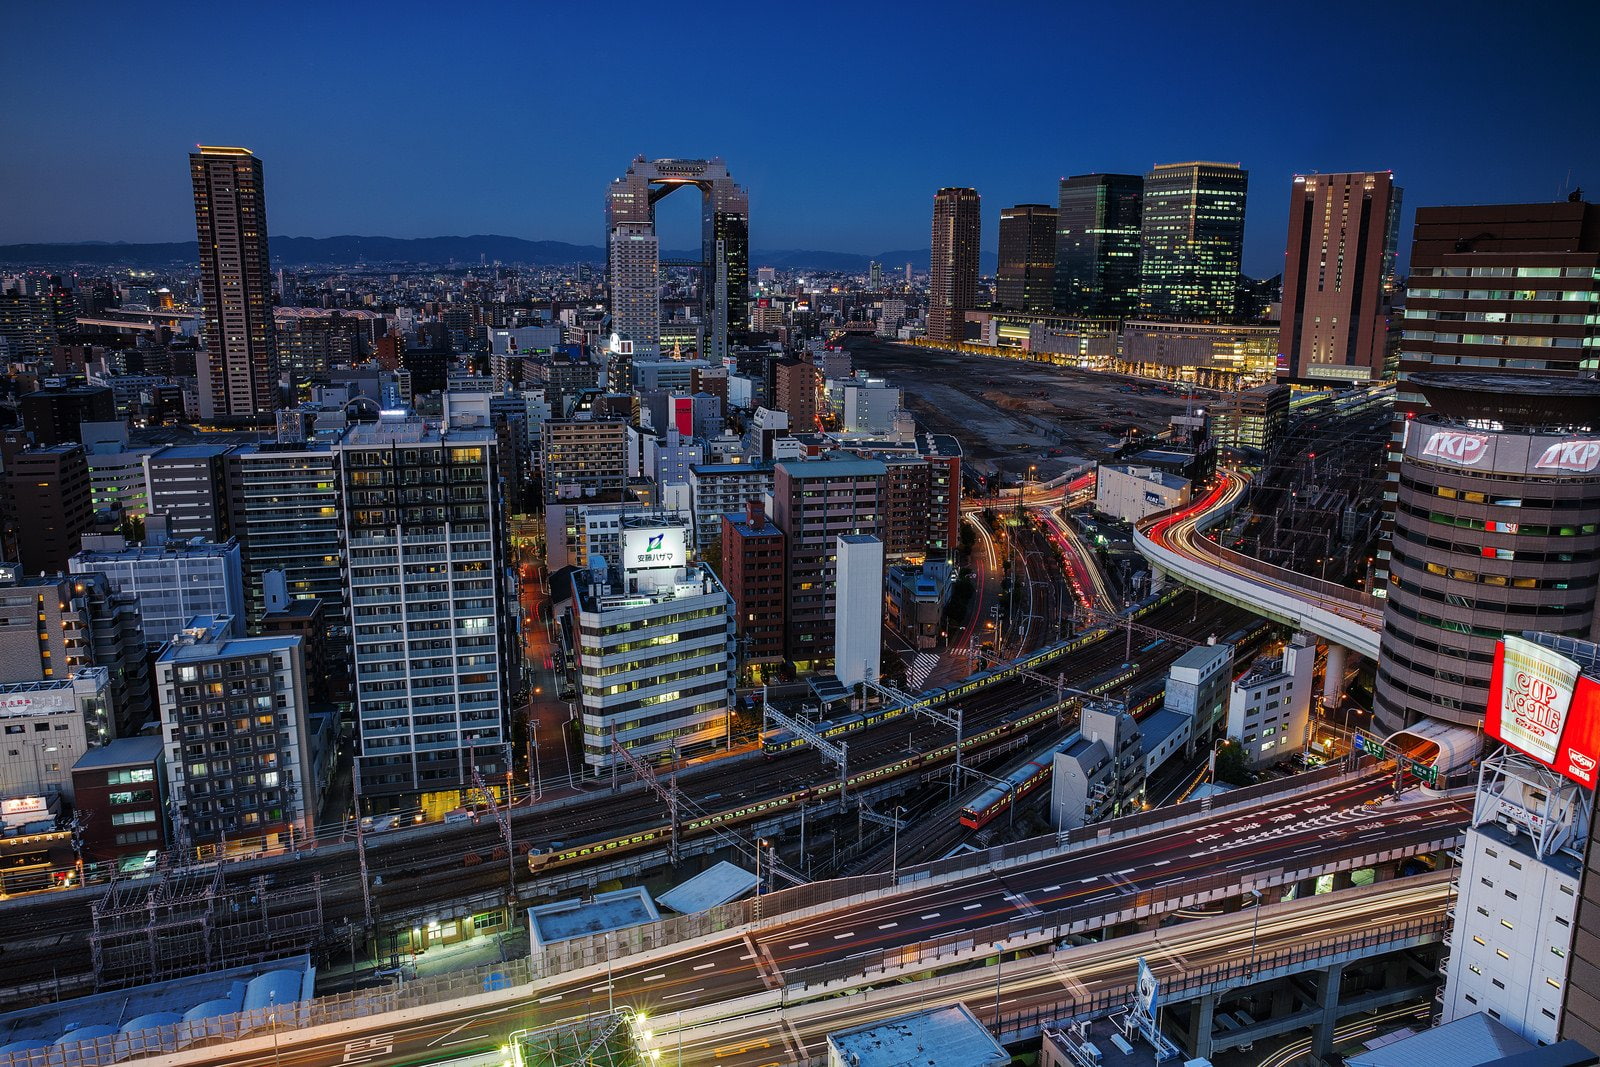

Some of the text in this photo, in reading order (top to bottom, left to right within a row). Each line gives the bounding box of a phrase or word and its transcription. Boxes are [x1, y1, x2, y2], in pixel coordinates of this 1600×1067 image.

[1427, 433, 1483, 458] TKP
[1544, 440, 1600, 467] TKP
[638, 553, 673, 563] 安藤ハザマ
[1516, 671, 1557, 705] CUP
[1505, 687, 1561, 734] NOODLE
